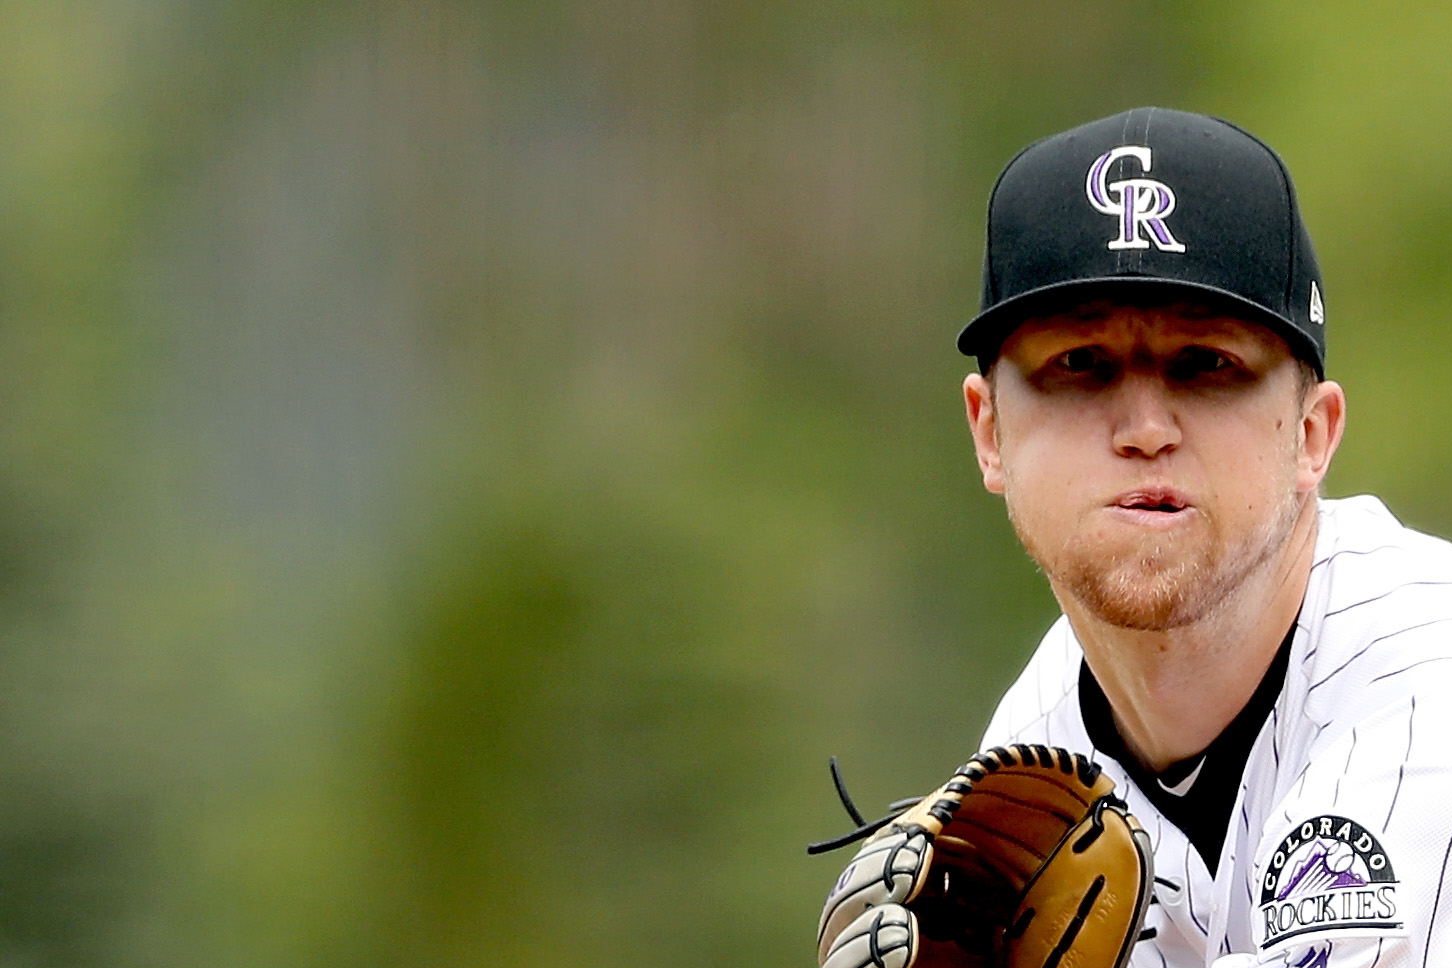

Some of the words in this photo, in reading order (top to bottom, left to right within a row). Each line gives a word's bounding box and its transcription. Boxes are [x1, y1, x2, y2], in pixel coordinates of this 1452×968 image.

[1086, 146, 1185, 253] CR
[1265, 817, 1386, 890] COLORADO
[1263, 886, 1397, 941] ROCKIES
